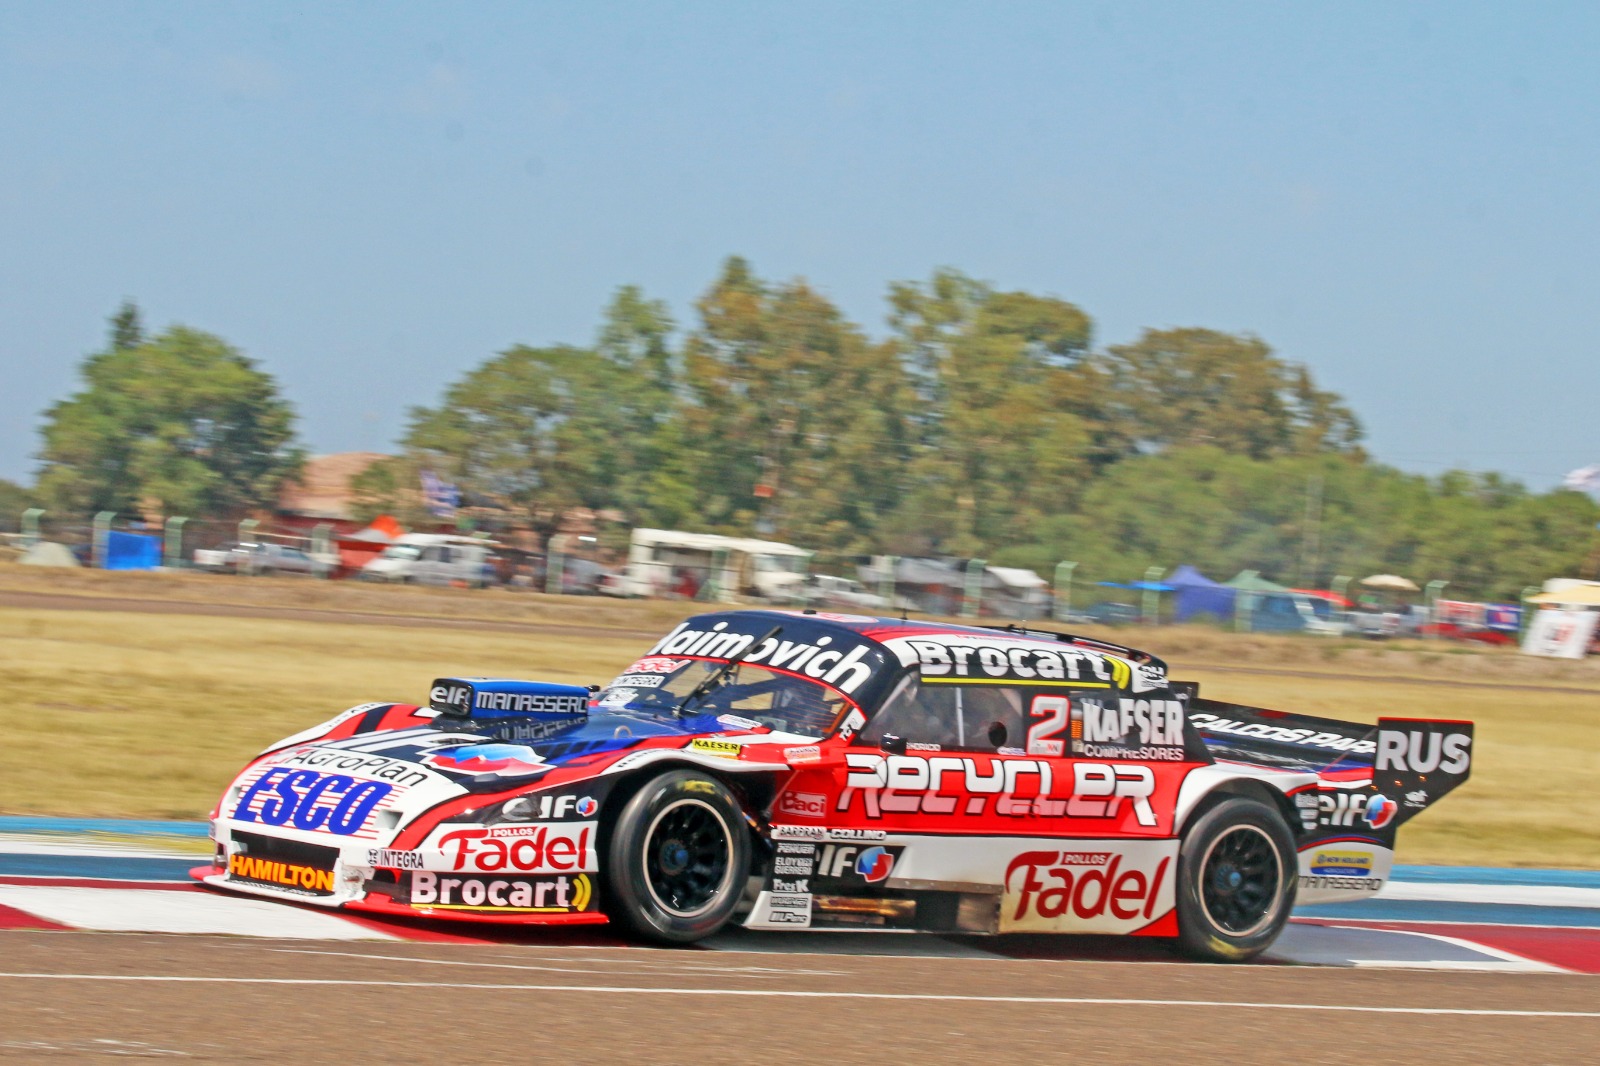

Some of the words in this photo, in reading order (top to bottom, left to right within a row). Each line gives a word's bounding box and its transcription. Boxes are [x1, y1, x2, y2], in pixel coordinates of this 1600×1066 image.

[909, 640, 1111, 680] Brocart
[1028, 695, 1070, 756] 2
[695, 740, 739, 751] KAESER
[1375, 730, 1472, 774] RUS
[233, 766, 392, 836] ESCO
[439, 826, 590, 871] Fadel
[493, 828, 534, 837] POLLOS
[230, 854, 335, 892] HAMILTON
[381, 851, 424, 869] INTEGRA
[815, 844, 857, 878] lf
[1065, 855, 1106, 865] POLLOS
[411, 871, 570, 908] Brocart
[1005, 851, 1170, 921] Fadel
